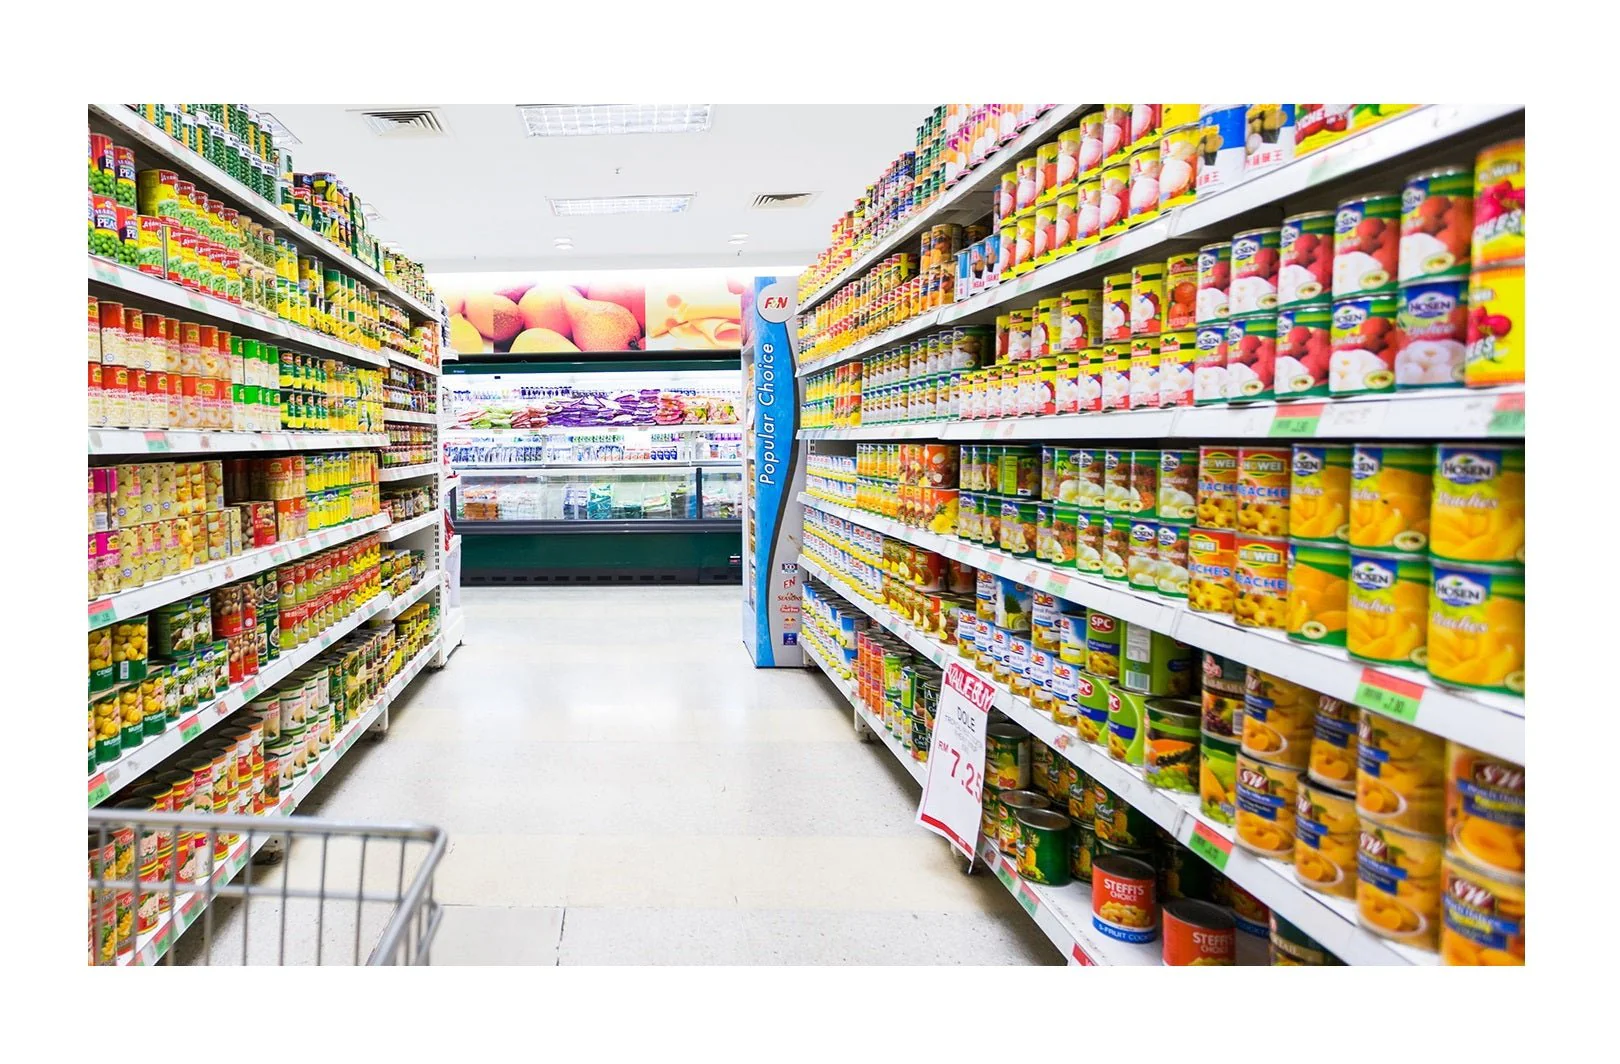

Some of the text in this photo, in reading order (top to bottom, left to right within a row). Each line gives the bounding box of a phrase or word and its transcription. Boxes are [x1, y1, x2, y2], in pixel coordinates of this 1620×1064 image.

[1409, 300, 1452, 312] HOSEN
[757, 343, 780, 486] Popular Choice
[1443, 462, 1491, 477] HOSEN
[1437, 491, 1498, 510] Peaches
[1352, 569, 1389, 584] HOSEN
[1436, 584, 1480, 600] HOSEN
[1091, 616, 1111, 629] SPC
[957, 706, 976, 732] DOLE
[950, 748, 982, 804] 7.25
[1103, 878, 1145, 896] STEFFI'S
[1110, 890, 1137, 902] CHOICE
